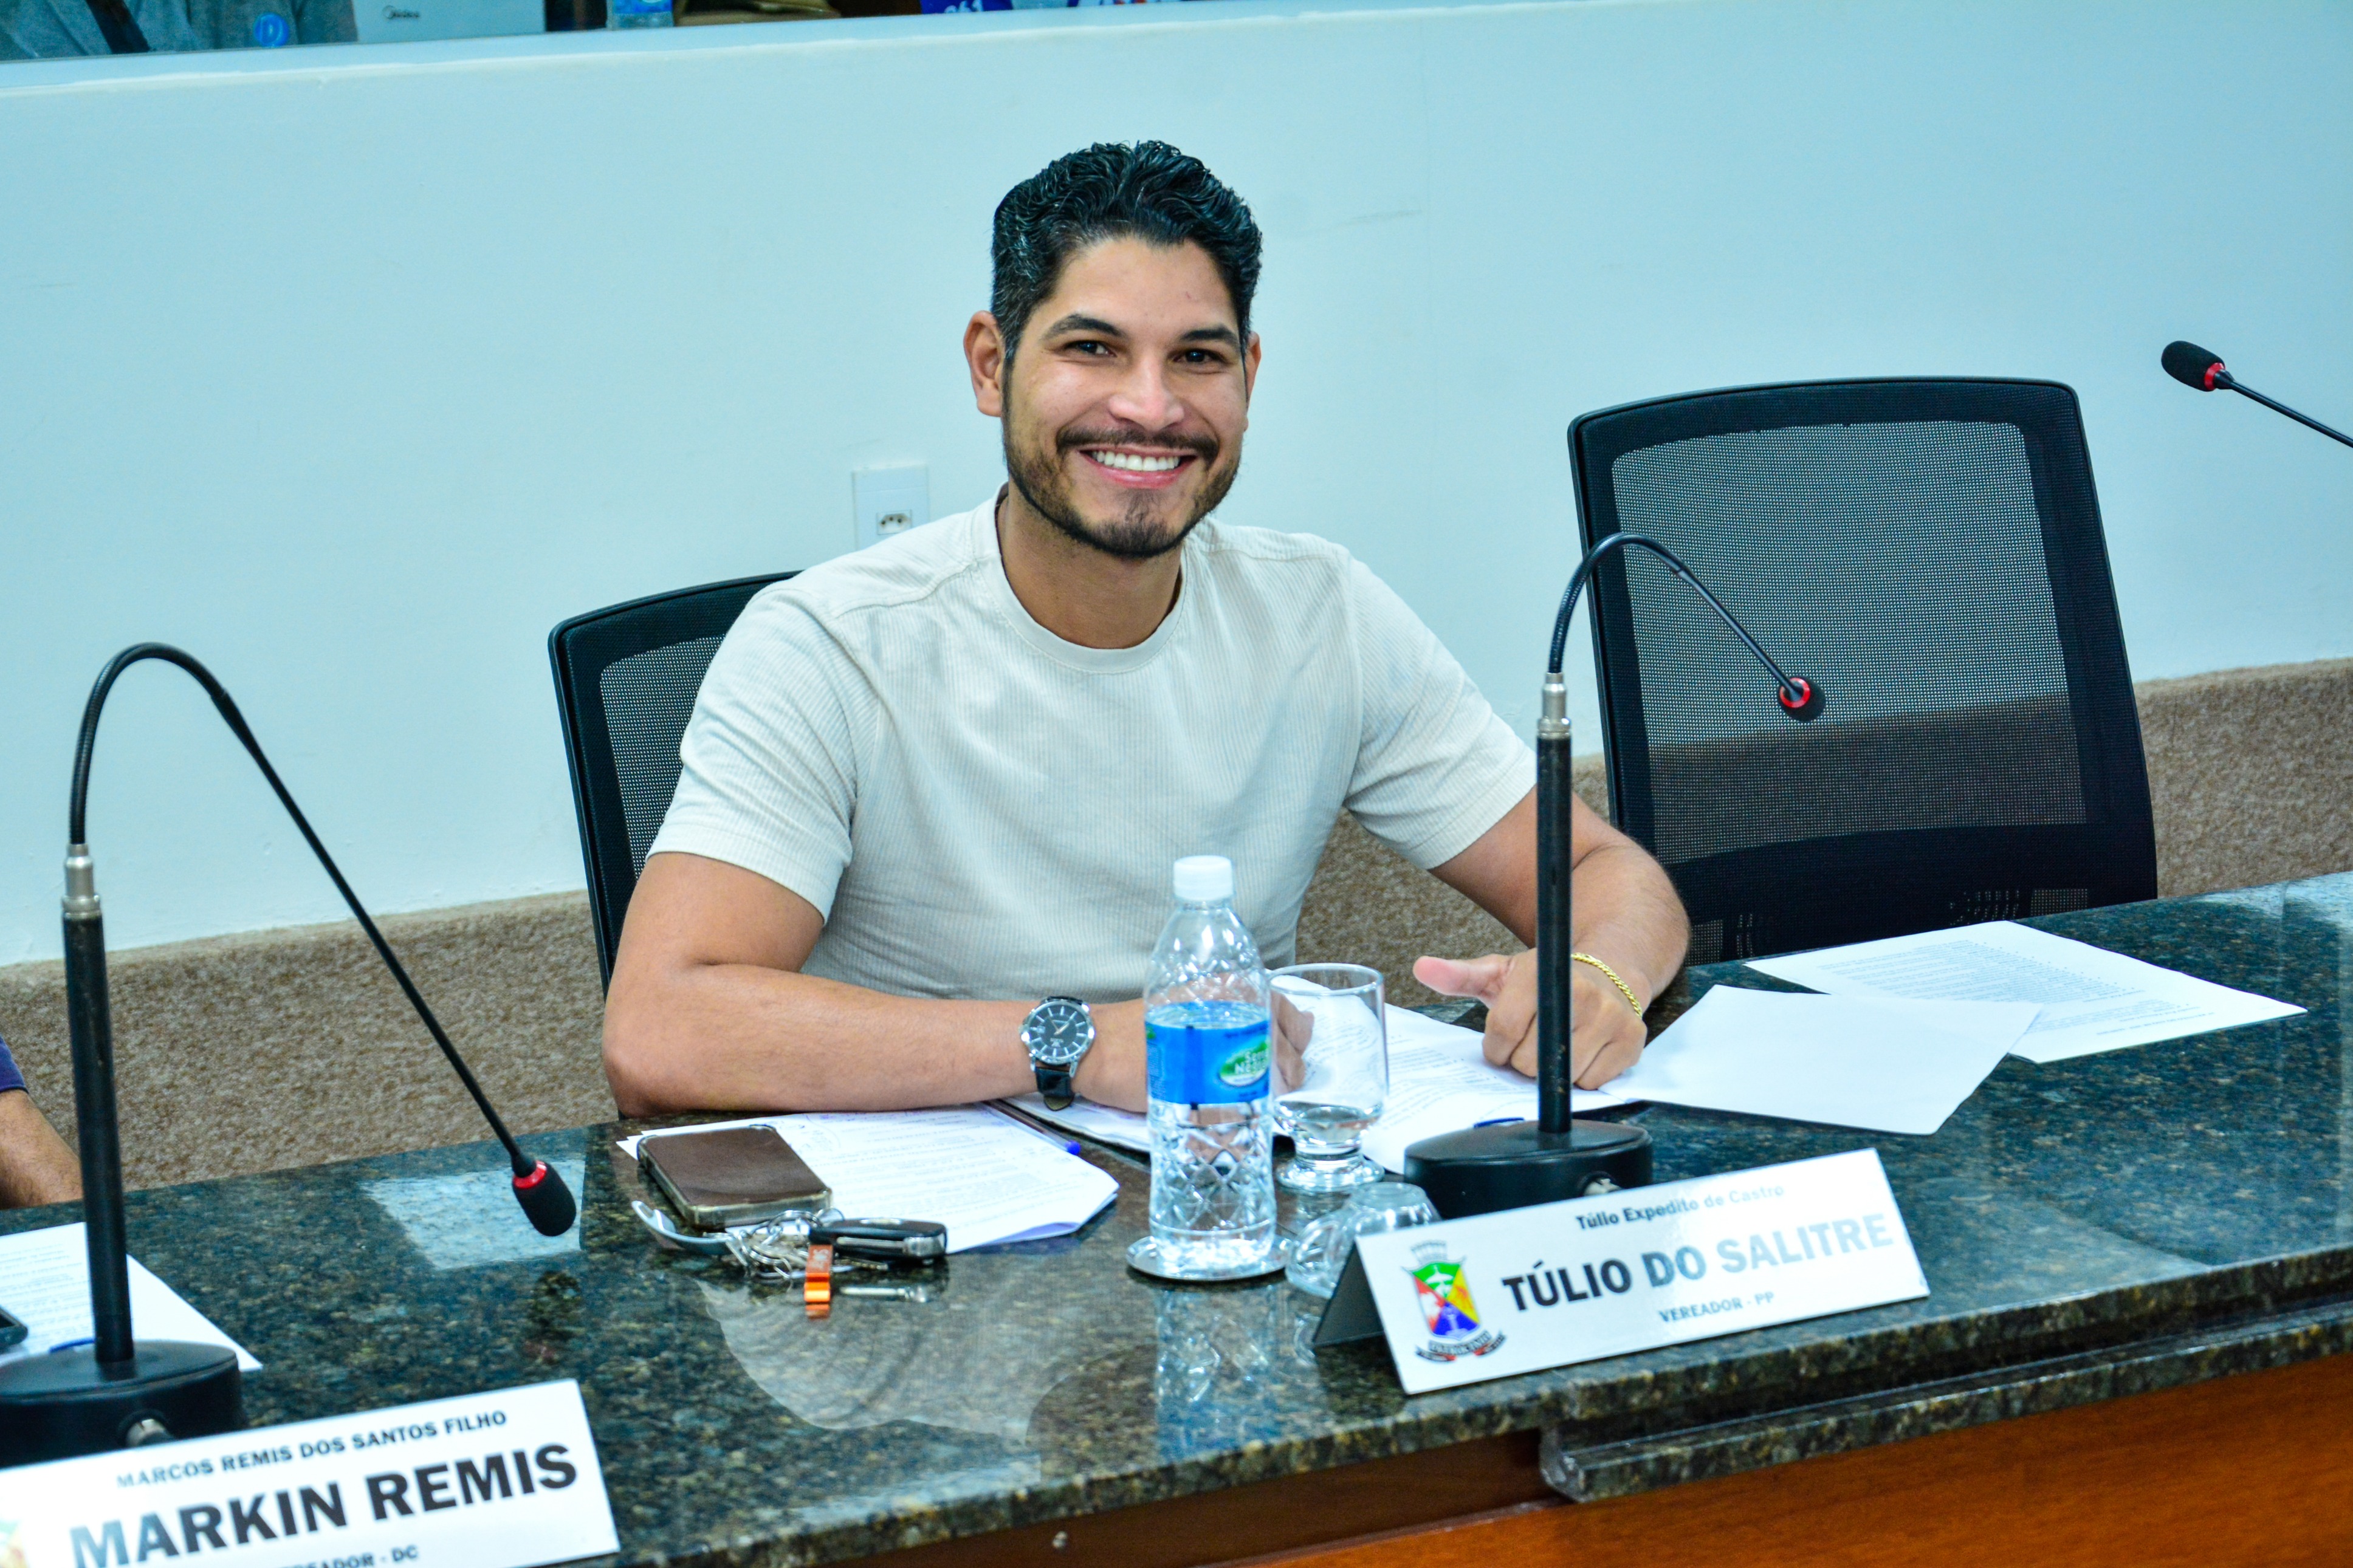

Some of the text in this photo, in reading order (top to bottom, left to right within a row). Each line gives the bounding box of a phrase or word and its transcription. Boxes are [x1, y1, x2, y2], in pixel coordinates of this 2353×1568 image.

[1576, 1184, 1785, 1230] Túlio Expedito de Castro
[1501, 1213, 1893, 1311] TÚLIO DO SALITRE
[1658, 1296, 1743, 1324] VEREADOR
[1755, 1292, 1774, 1306] PP
[116, 1410, 507, 1488] MARCOS REMIS DOS SANTOS FILHO
[69, 1443, 578, 1568] MARKIN REMIS
[391, 1545, 418, 1562] DC
